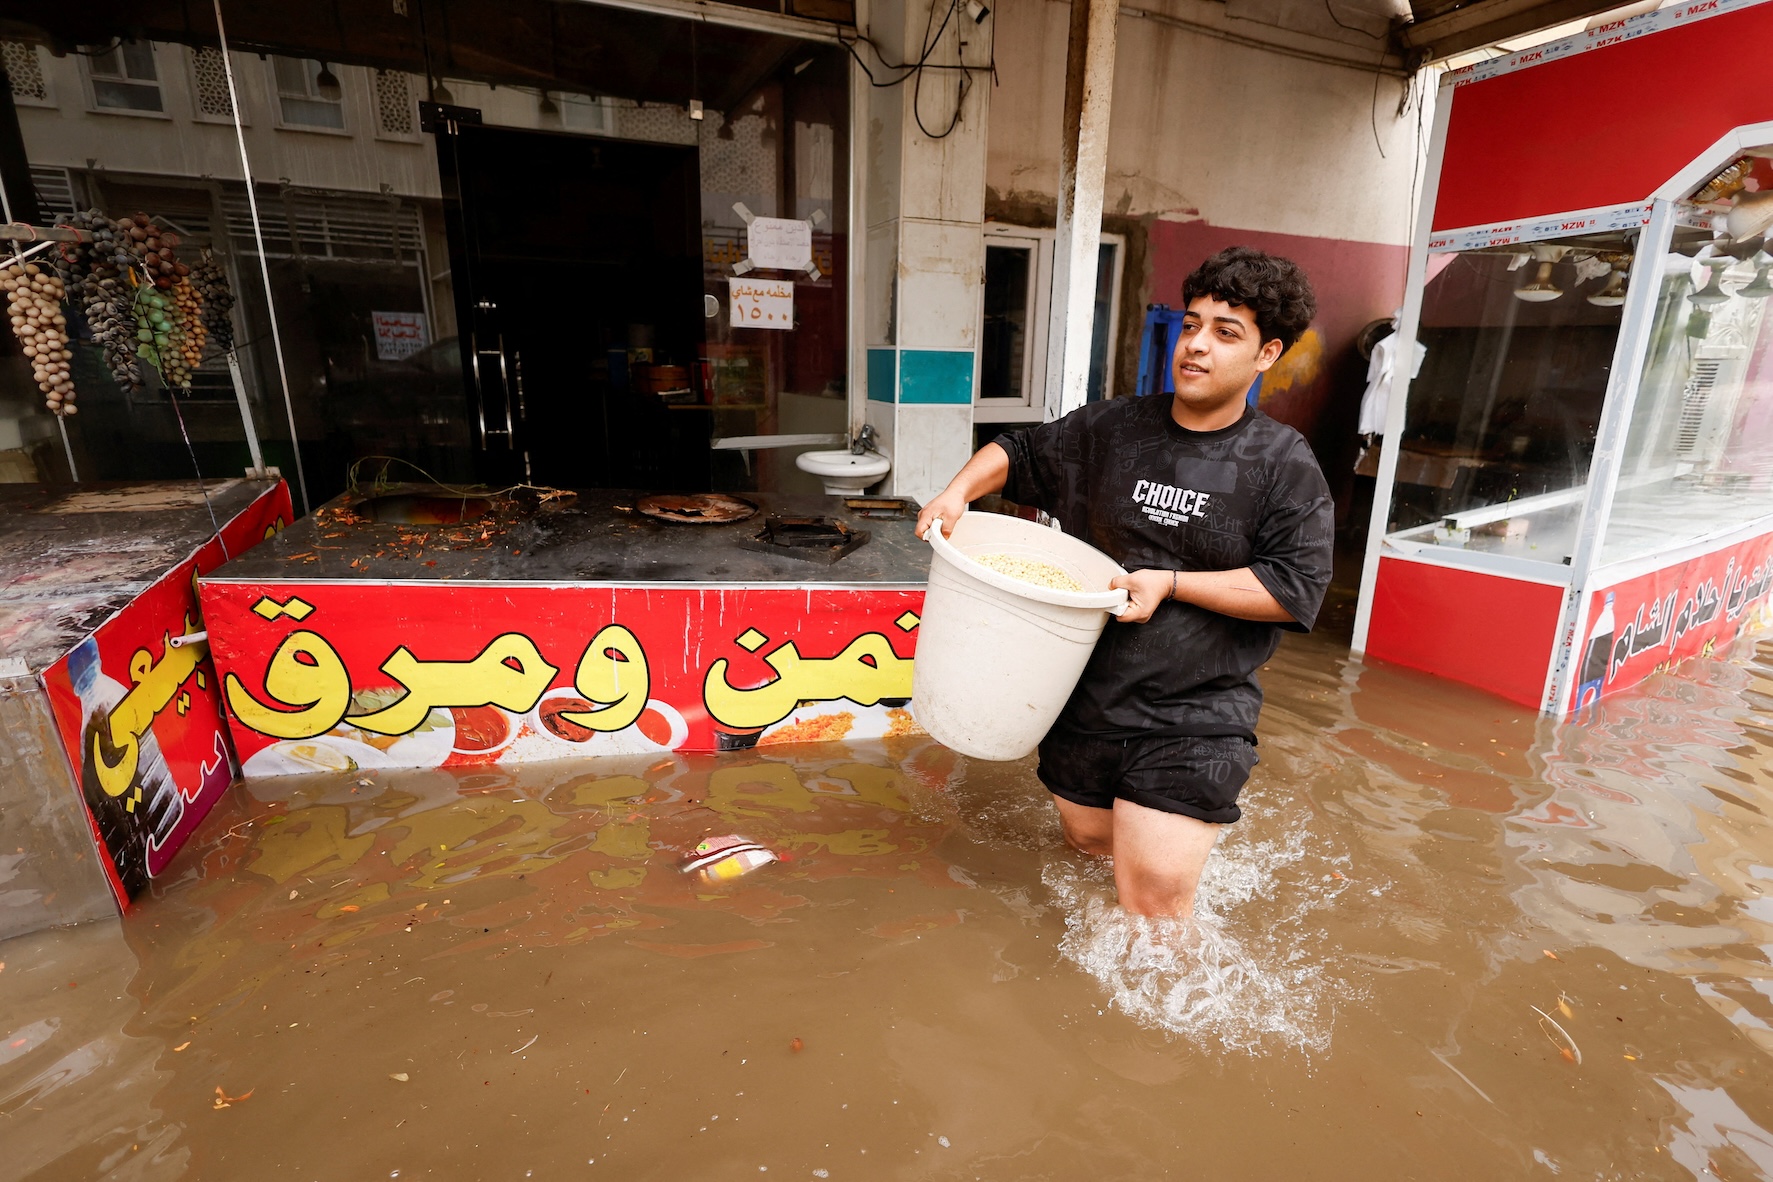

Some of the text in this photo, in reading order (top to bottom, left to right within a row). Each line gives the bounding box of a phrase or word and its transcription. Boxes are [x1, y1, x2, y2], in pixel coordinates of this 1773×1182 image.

[1687, 0, 1718, 15] MZK
[1599, 19, 1625, 34] MZK
[1519, 51, 1542, 64] MZK
[1561, 219, 1585, 231] MZK
[731, 285, 752, 300] شاي
[752, 288, 765, 303] مع
[737, 303, 788, 322] ١٥٠٠
[1131, 479, 1211, 519] CHOICE
[1608, 588, 1679, 685] الشام
